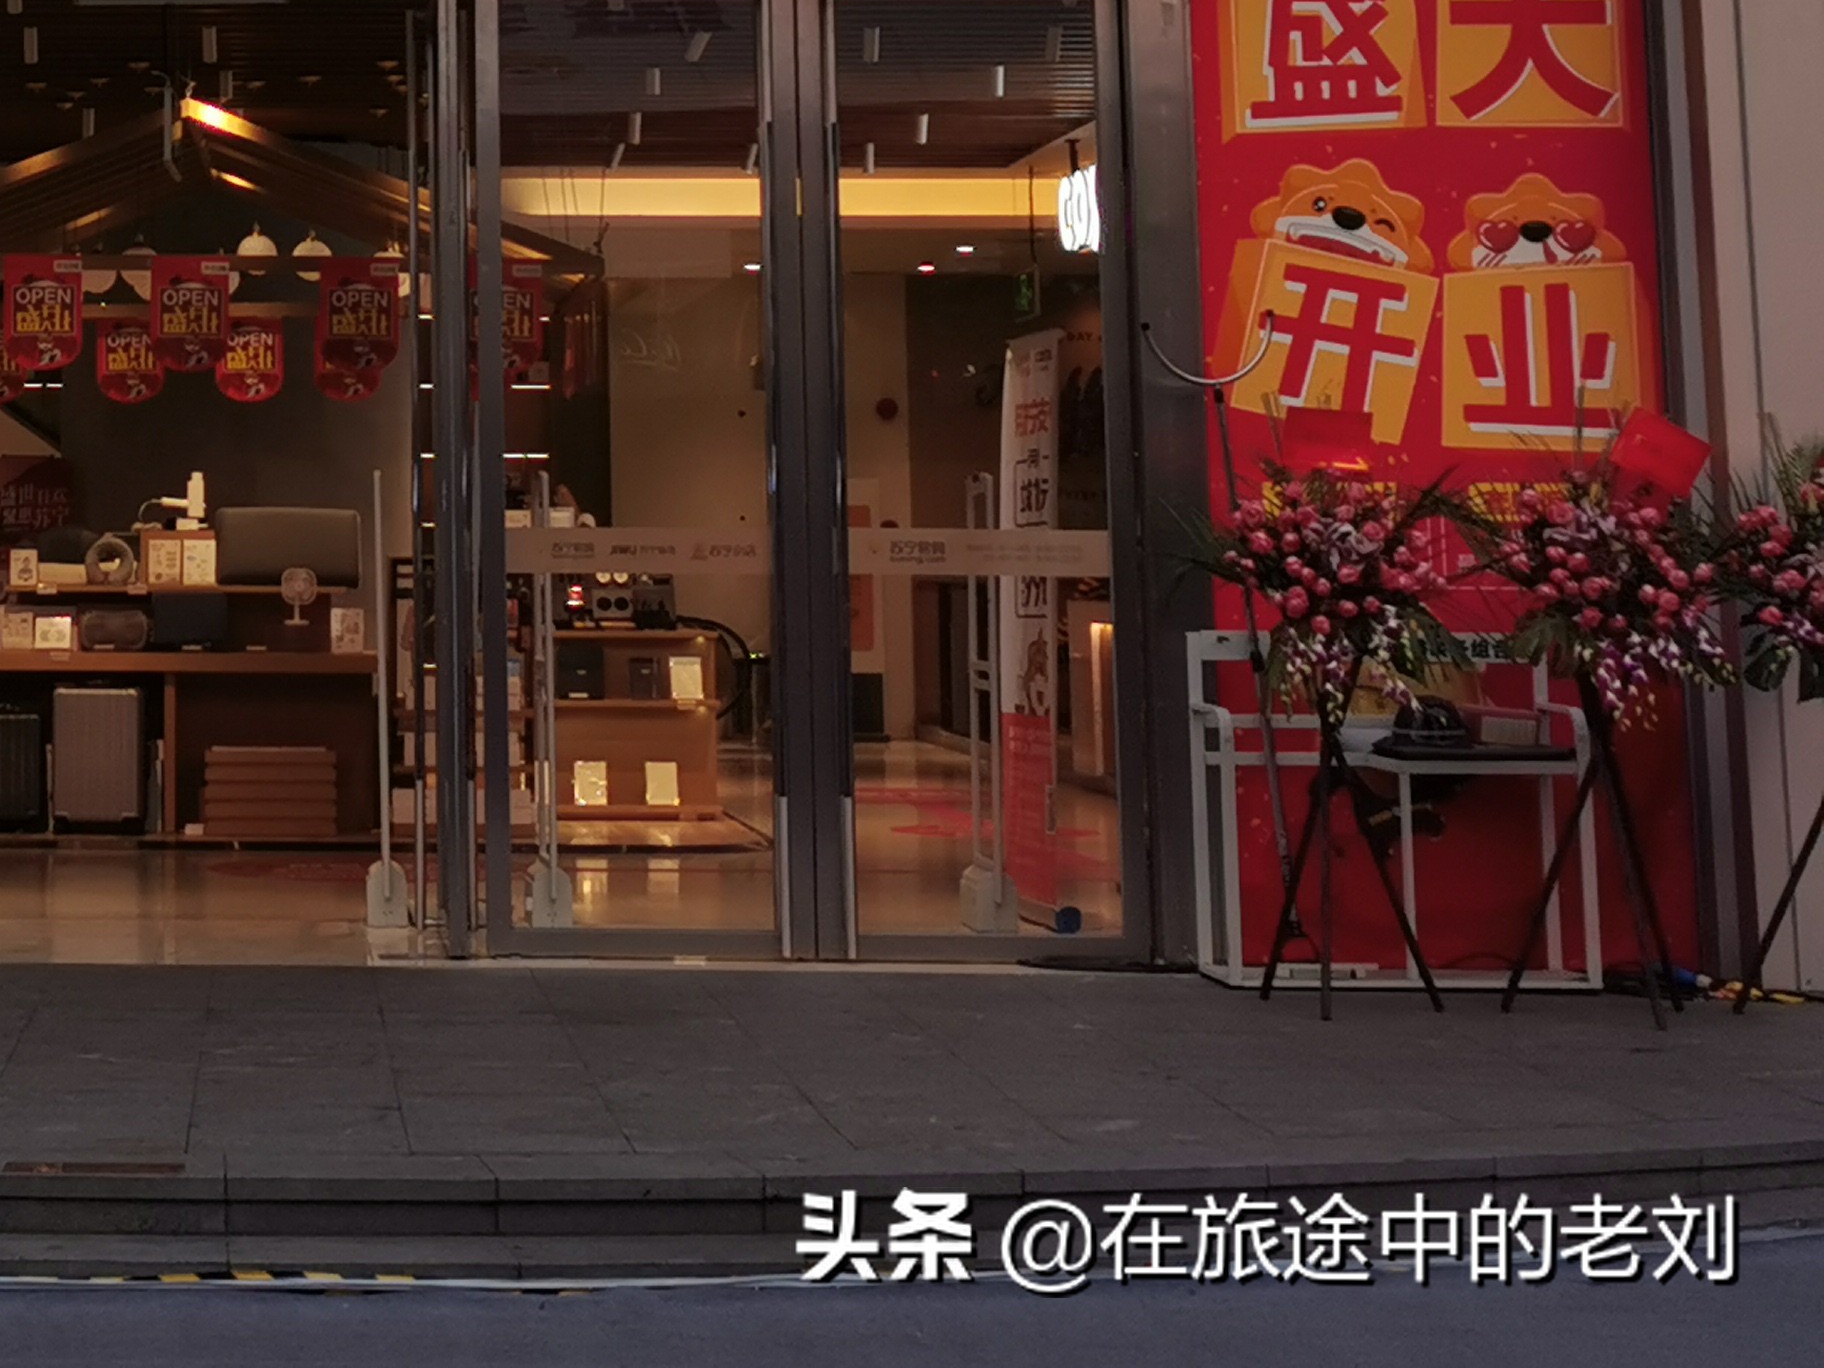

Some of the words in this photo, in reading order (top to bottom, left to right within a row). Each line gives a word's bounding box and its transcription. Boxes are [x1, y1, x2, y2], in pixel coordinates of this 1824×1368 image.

[16, 287, 72, 306] OPEN
[163, 288, 219, 307] OPEN
[331, 290, 389, 308] OPEN
[227, 332, 274, 348] OPEN
[1258, 263, 1618, 437] 开业
